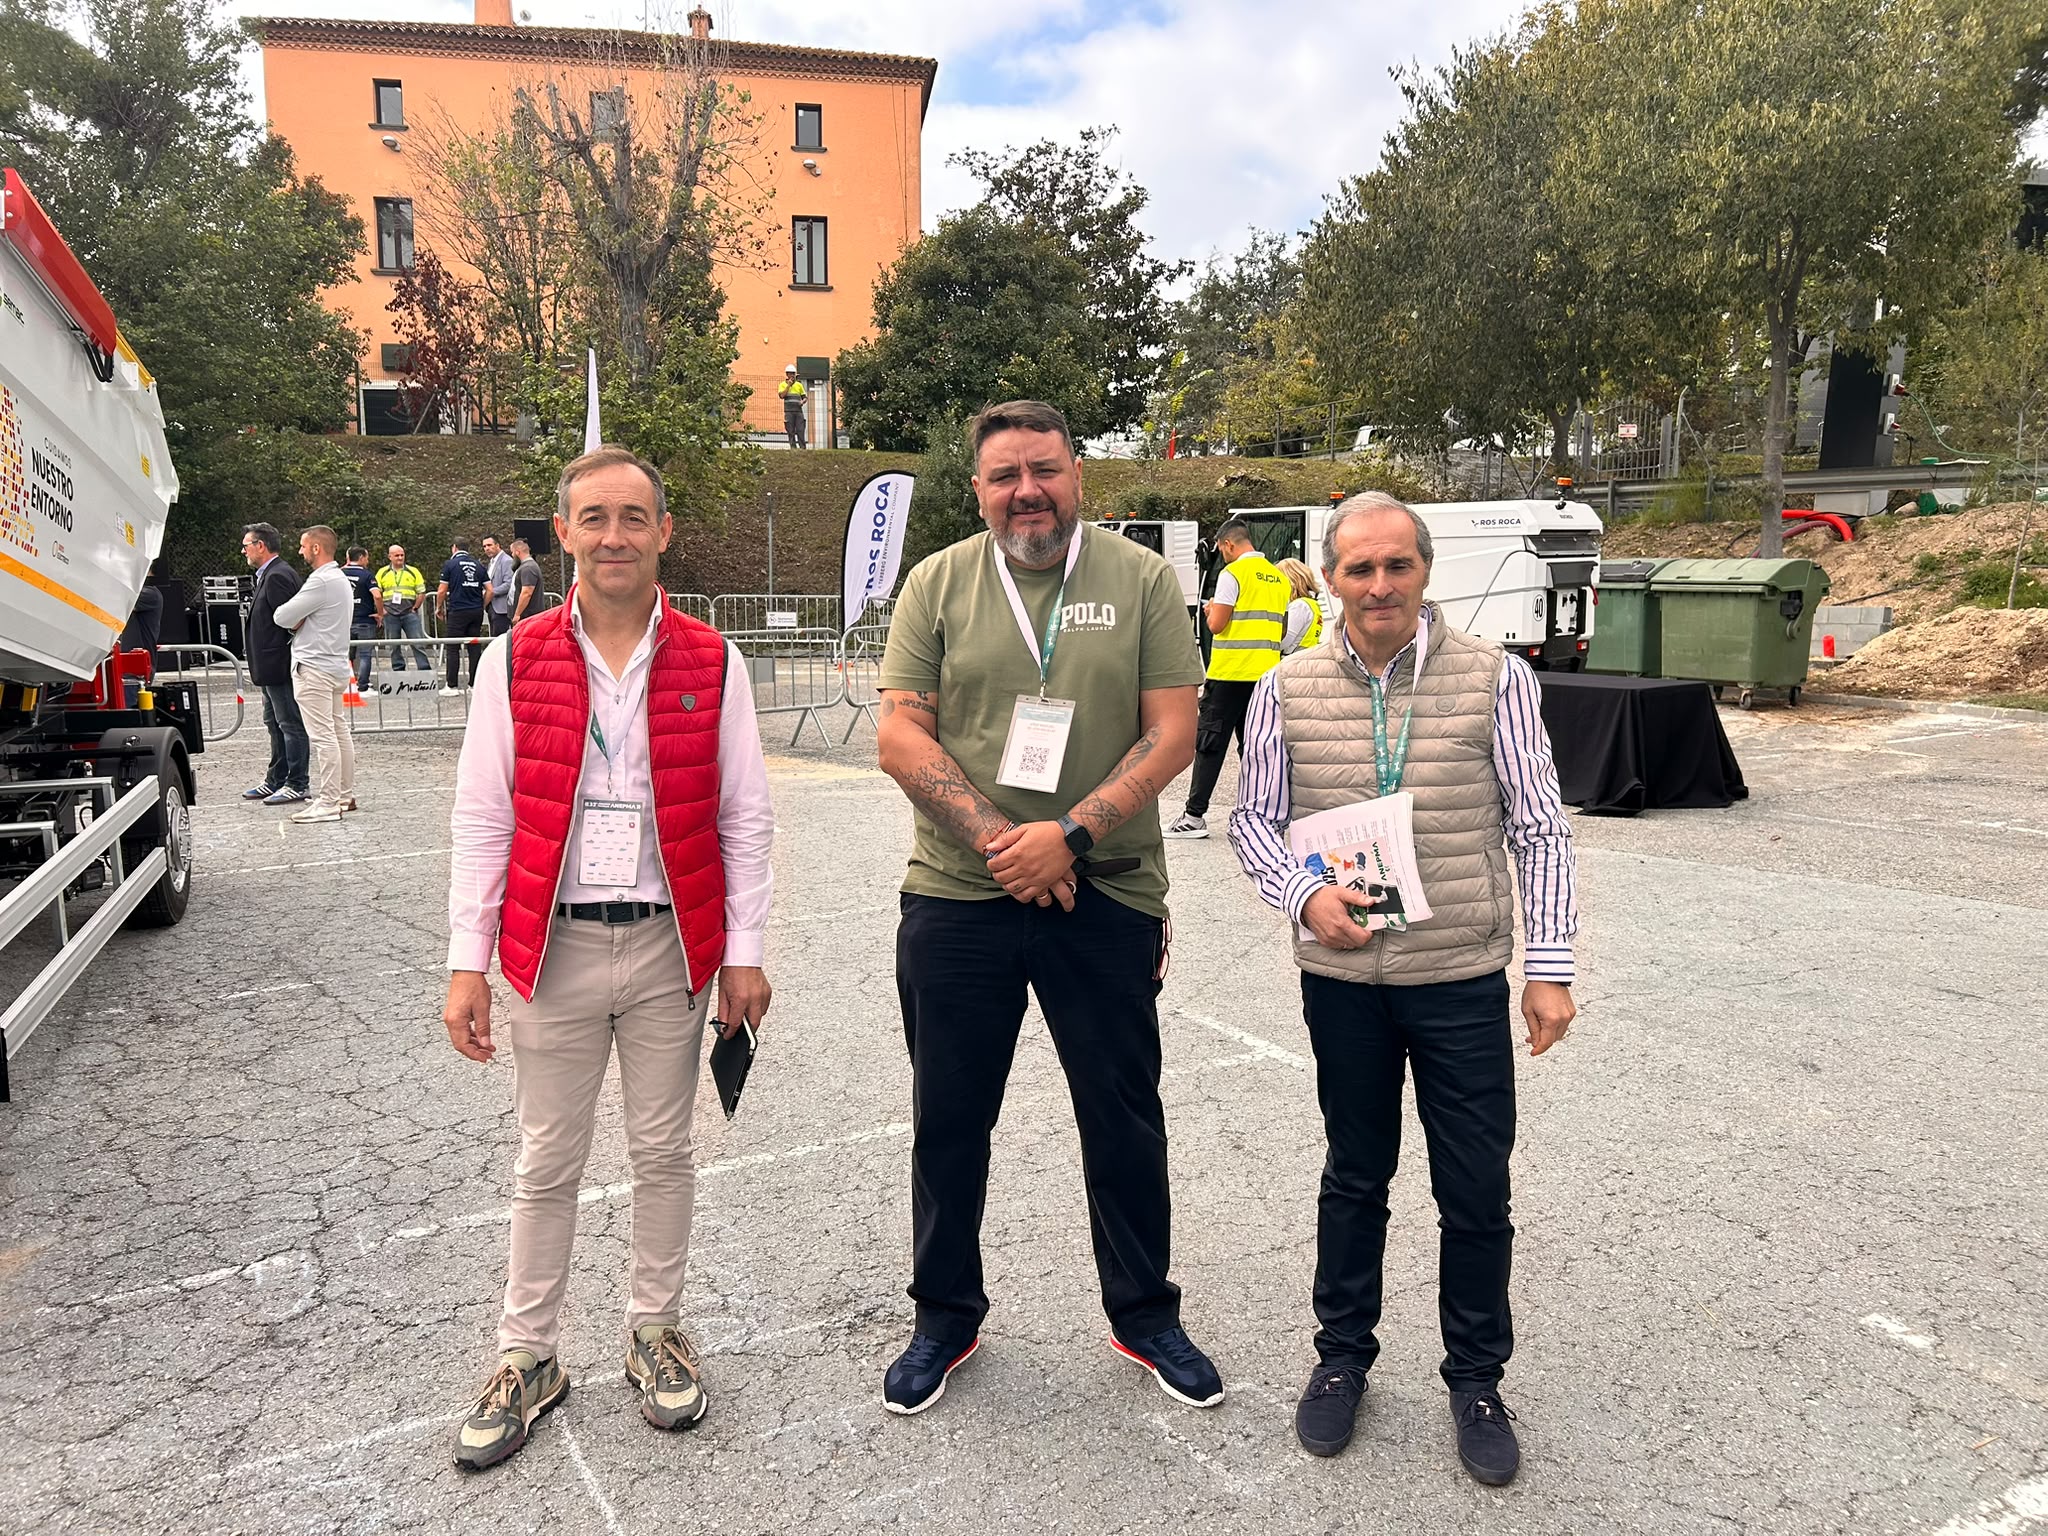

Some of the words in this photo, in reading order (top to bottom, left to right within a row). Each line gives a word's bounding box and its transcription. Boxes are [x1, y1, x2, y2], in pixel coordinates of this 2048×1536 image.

[31, 446, 74, 501] NUESTRO
[31, 482, 73, 533] ENTORNO
[871, 481, 891, 542] ROCA
[882, 512, 894, 560] ENVIRONMENTAL
[1060, 602, 1116, 631] POLO
[1534, 598, 1543, 618] 40
[1371, 841, 1387, 881] ANEPMA
